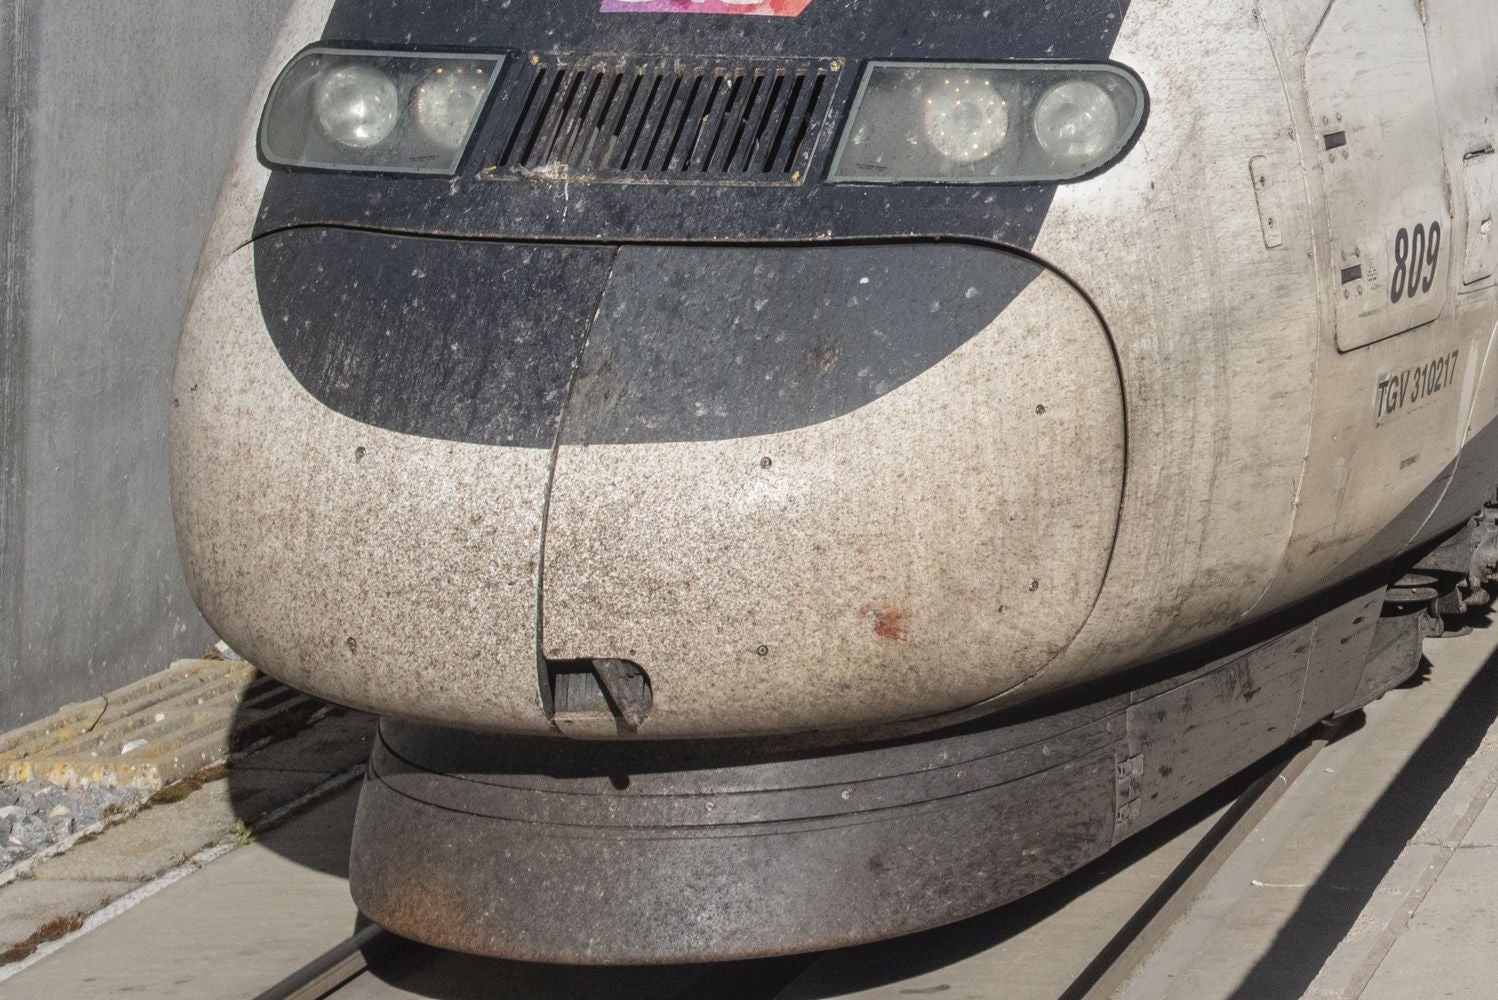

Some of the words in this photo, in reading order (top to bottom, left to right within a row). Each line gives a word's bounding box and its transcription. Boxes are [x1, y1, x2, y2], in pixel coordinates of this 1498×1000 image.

[1390, 220, 1441, 304] 809
[1377, 369, 1411, 418] TGV
[1411, 349, 1459, 403] 310217
